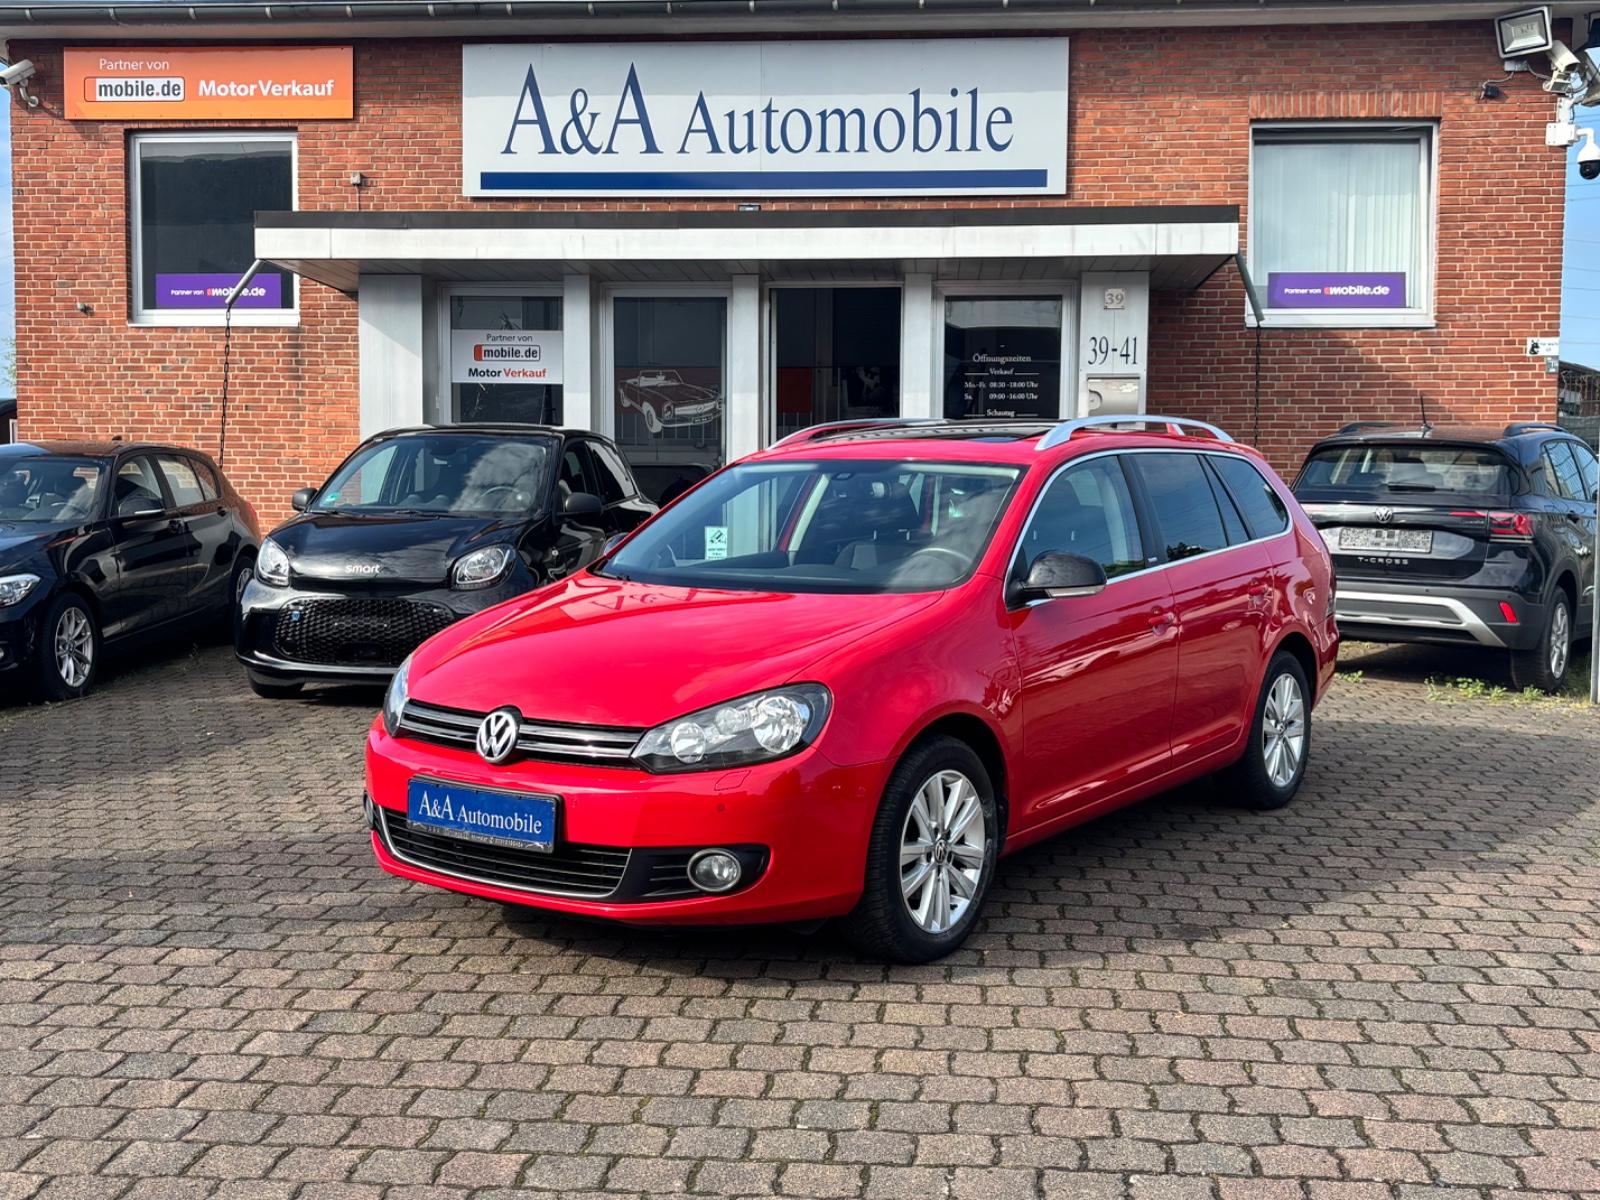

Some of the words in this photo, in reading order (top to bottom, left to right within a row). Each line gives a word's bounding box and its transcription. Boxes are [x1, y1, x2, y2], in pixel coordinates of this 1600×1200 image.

[99, 58, 143, 70] Partner
[148, 61, 169, 70] von
[98, 80, 181, 97] mobile.de
[500, 62, 663, 155] A&A
[676, 86, 1015, 155] Automobile
[1329, 285, 1390, 295] mobile.de
[1105, 293, 1124, 305] 39
[486, 333, 515, 342] Partner
[483, 347, 538, 358] mobile.de
[972, 353, 1032, 364] Öffnungszeiten
[1357, 556, 1409, 565] T-CROSS
[344, 564, 380, 574] smart
[418, 790, 454, 822] A&A
[457, 804, 542, 834] Automobile
